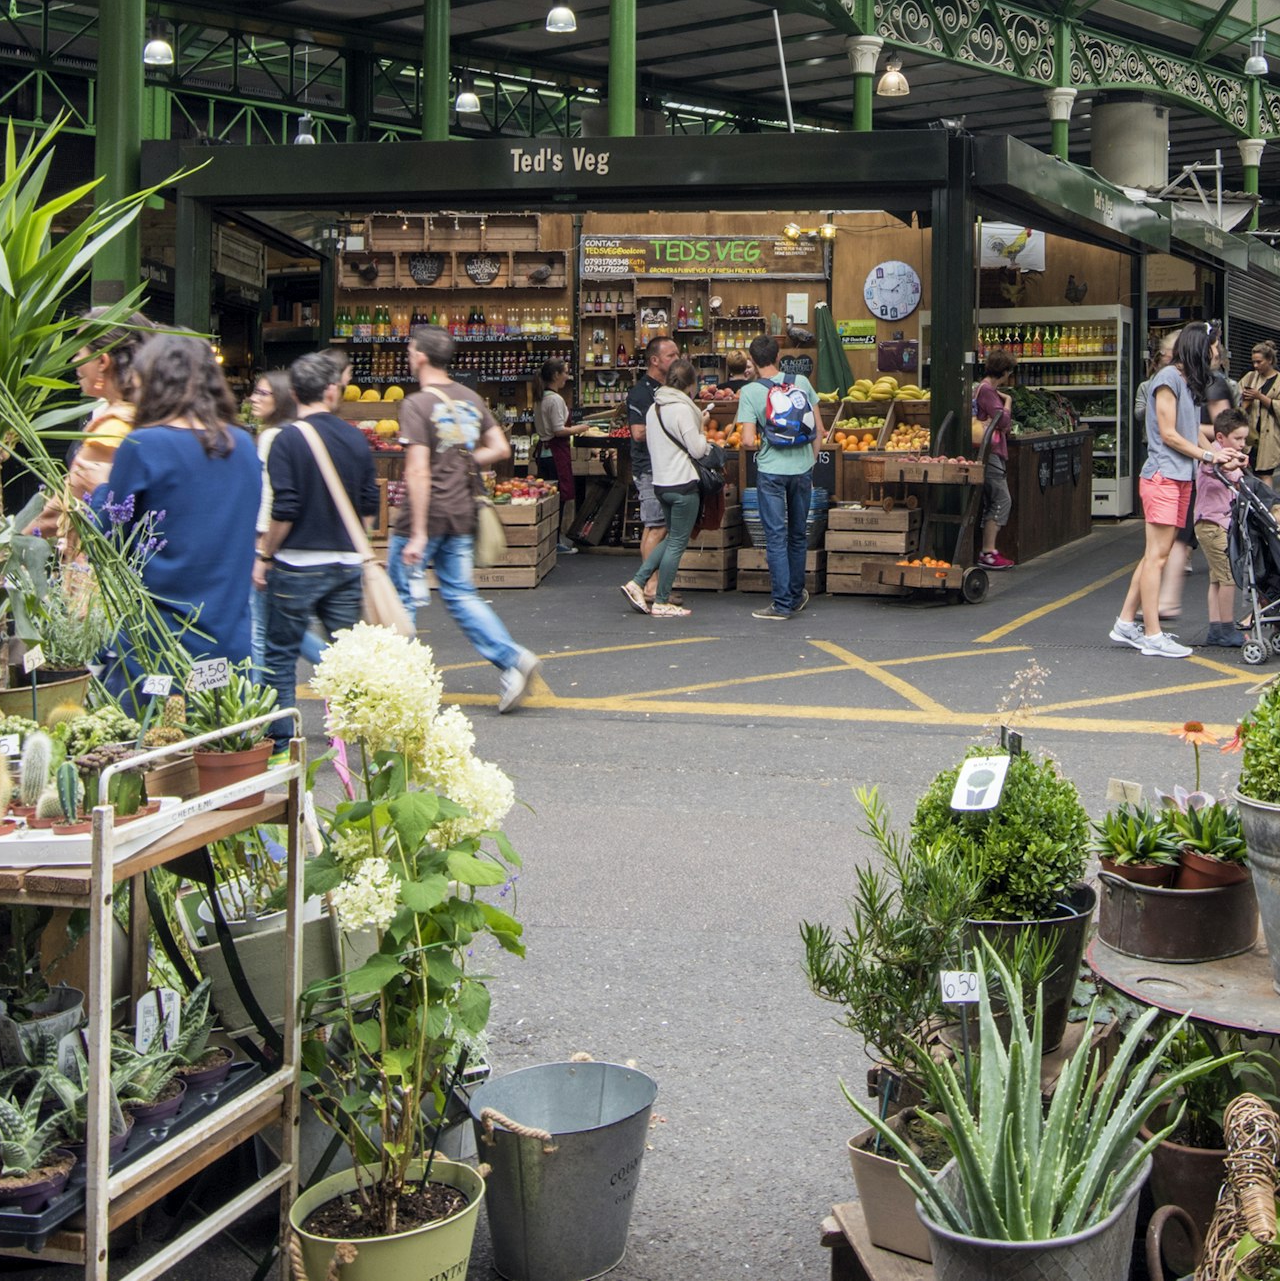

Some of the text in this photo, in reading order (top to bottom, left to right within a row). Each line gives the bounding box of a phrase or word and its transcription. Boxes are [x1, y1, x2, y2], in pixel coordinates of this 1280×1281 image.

[510, 147, 610, 175] Ted's Veg
[585, 240, 621, 248] CONTACT
[649, 240, 761, 262] TED'S VEG
[943, 971, 977, 998] 6.50
